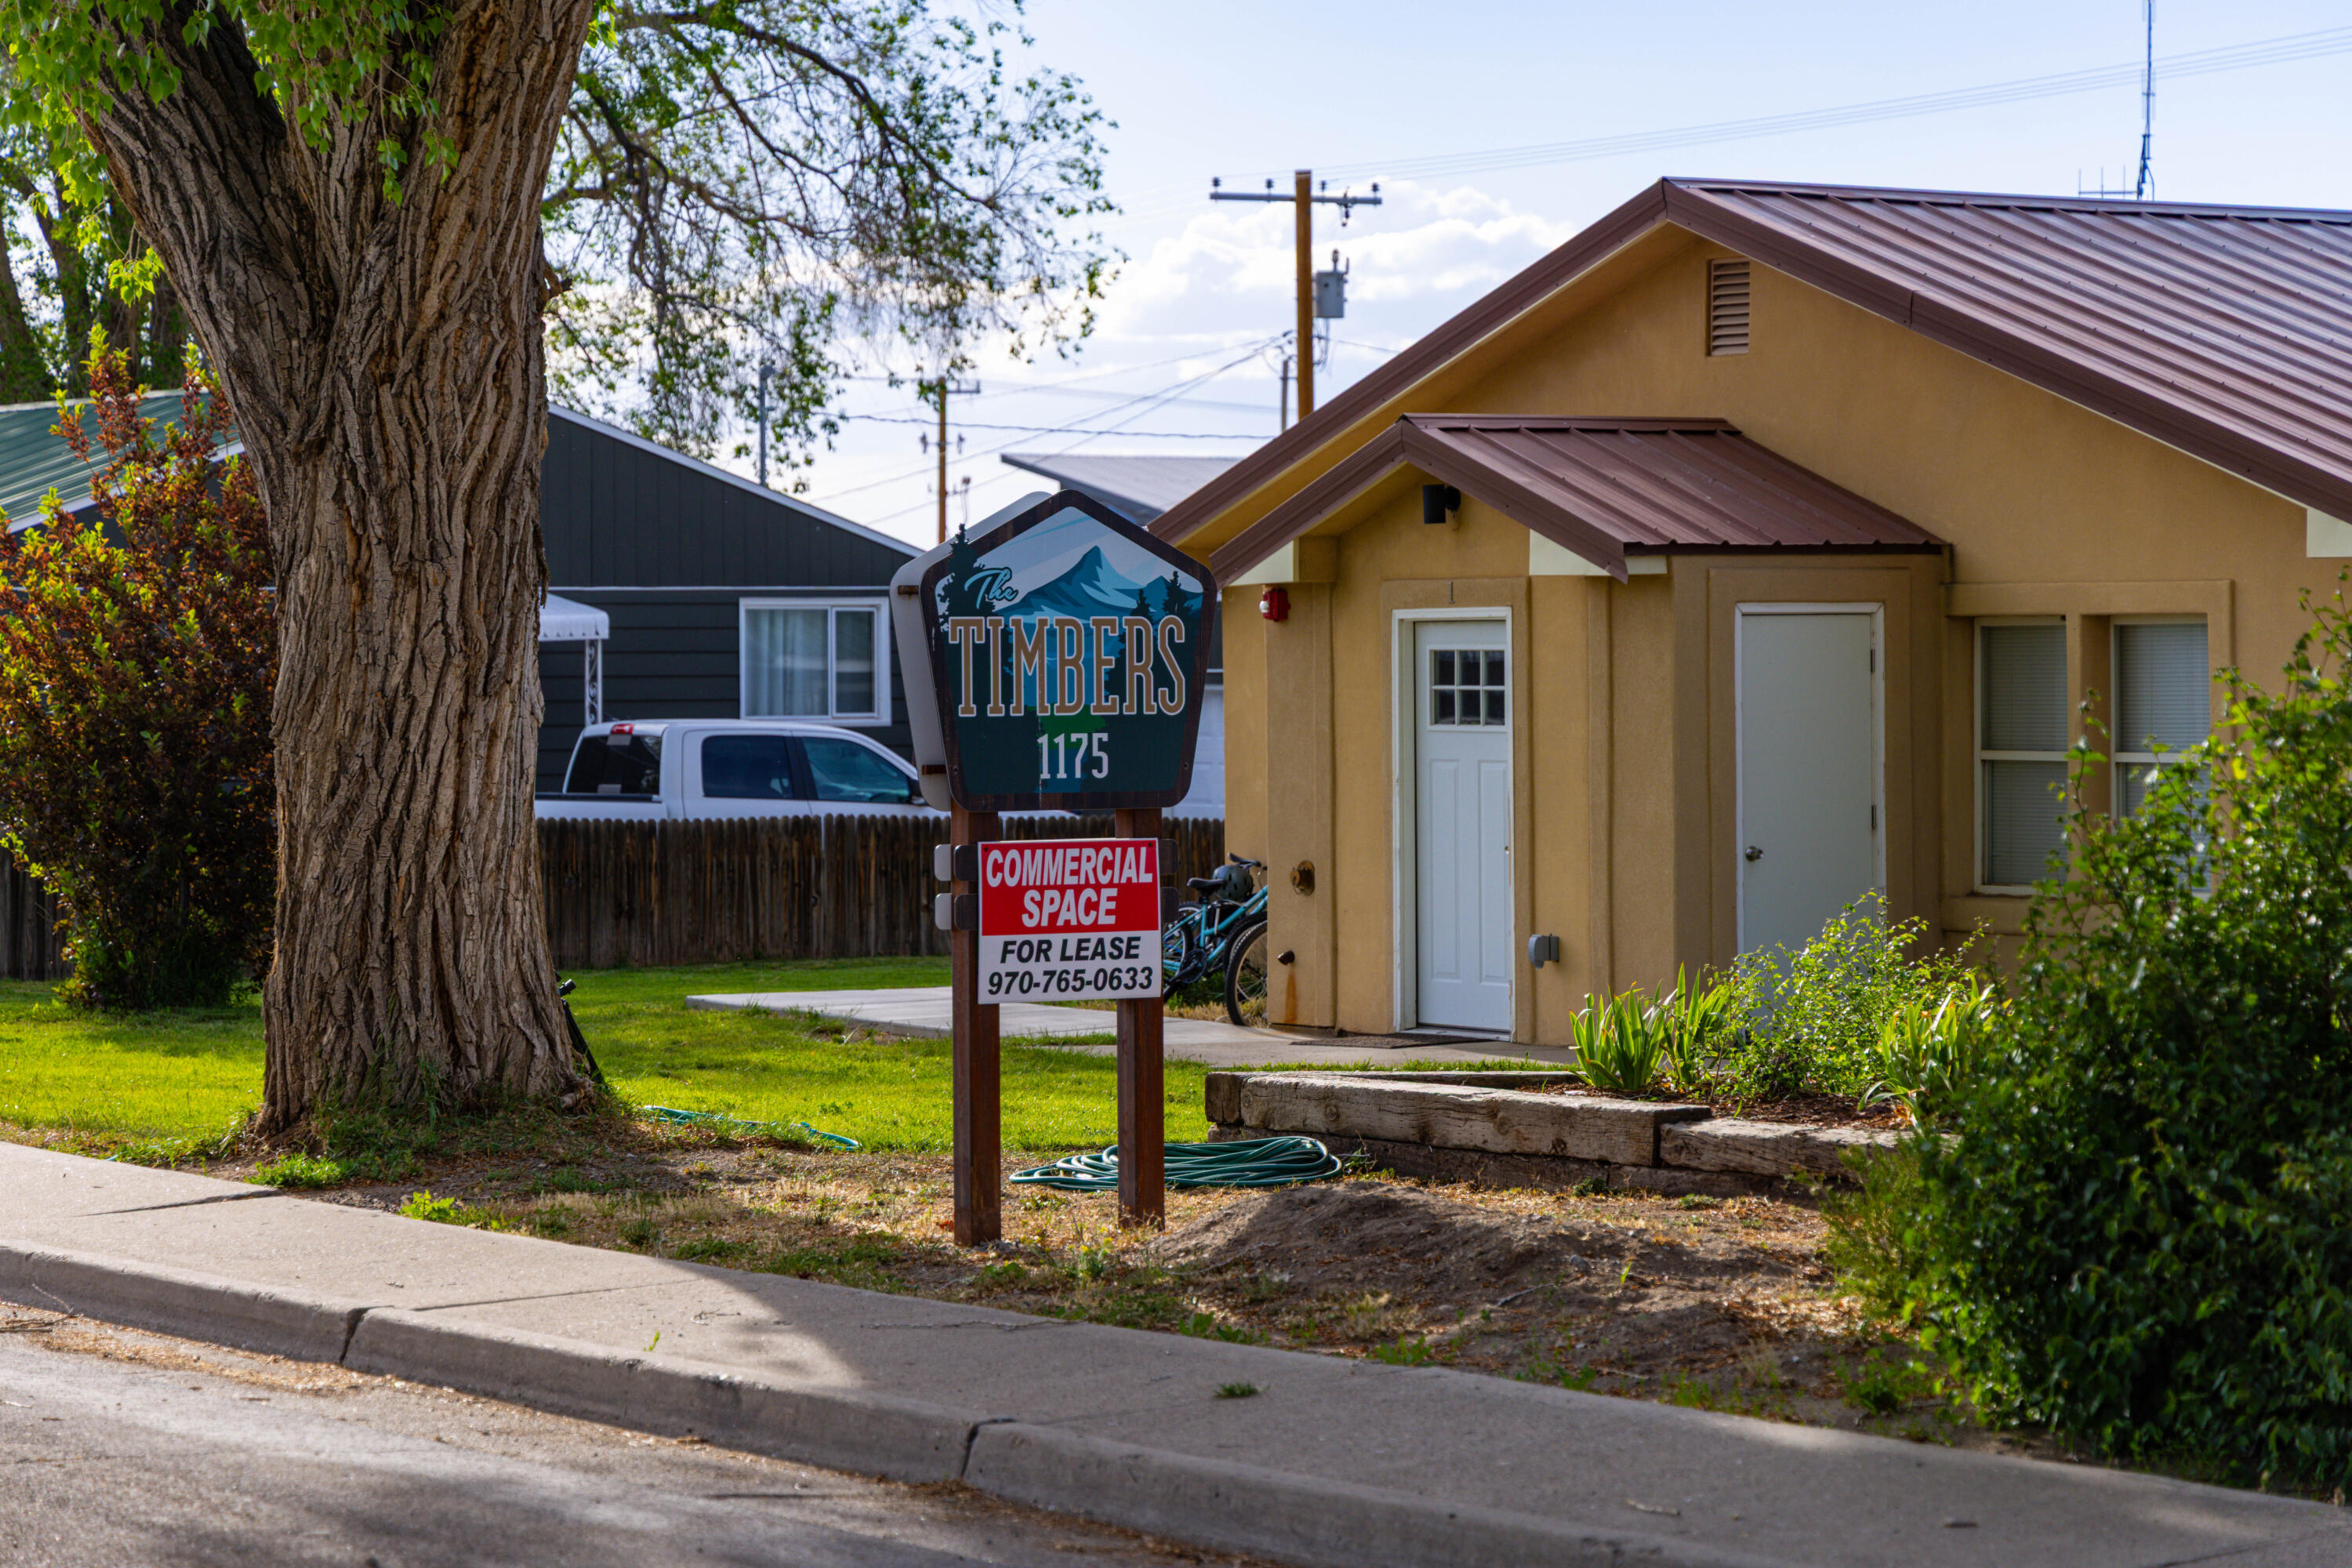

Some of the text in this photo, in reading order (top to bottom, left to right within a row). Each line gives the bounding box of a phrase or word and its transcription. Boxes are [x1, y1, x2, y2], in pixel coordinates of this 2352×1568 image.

[964, 568, 1018, 608] The
[949, 615, 1185, 716] TIMBERS
[1037, 733, 1108, 779] 1175
[987, 848, 1152, 887] COMMERCIAL
[1022, 888, 1117, 927] SPACE
[1000, 937, 1141, 963] FOR LEASE
[988, 967, 1152, 995] 970-765-0633
